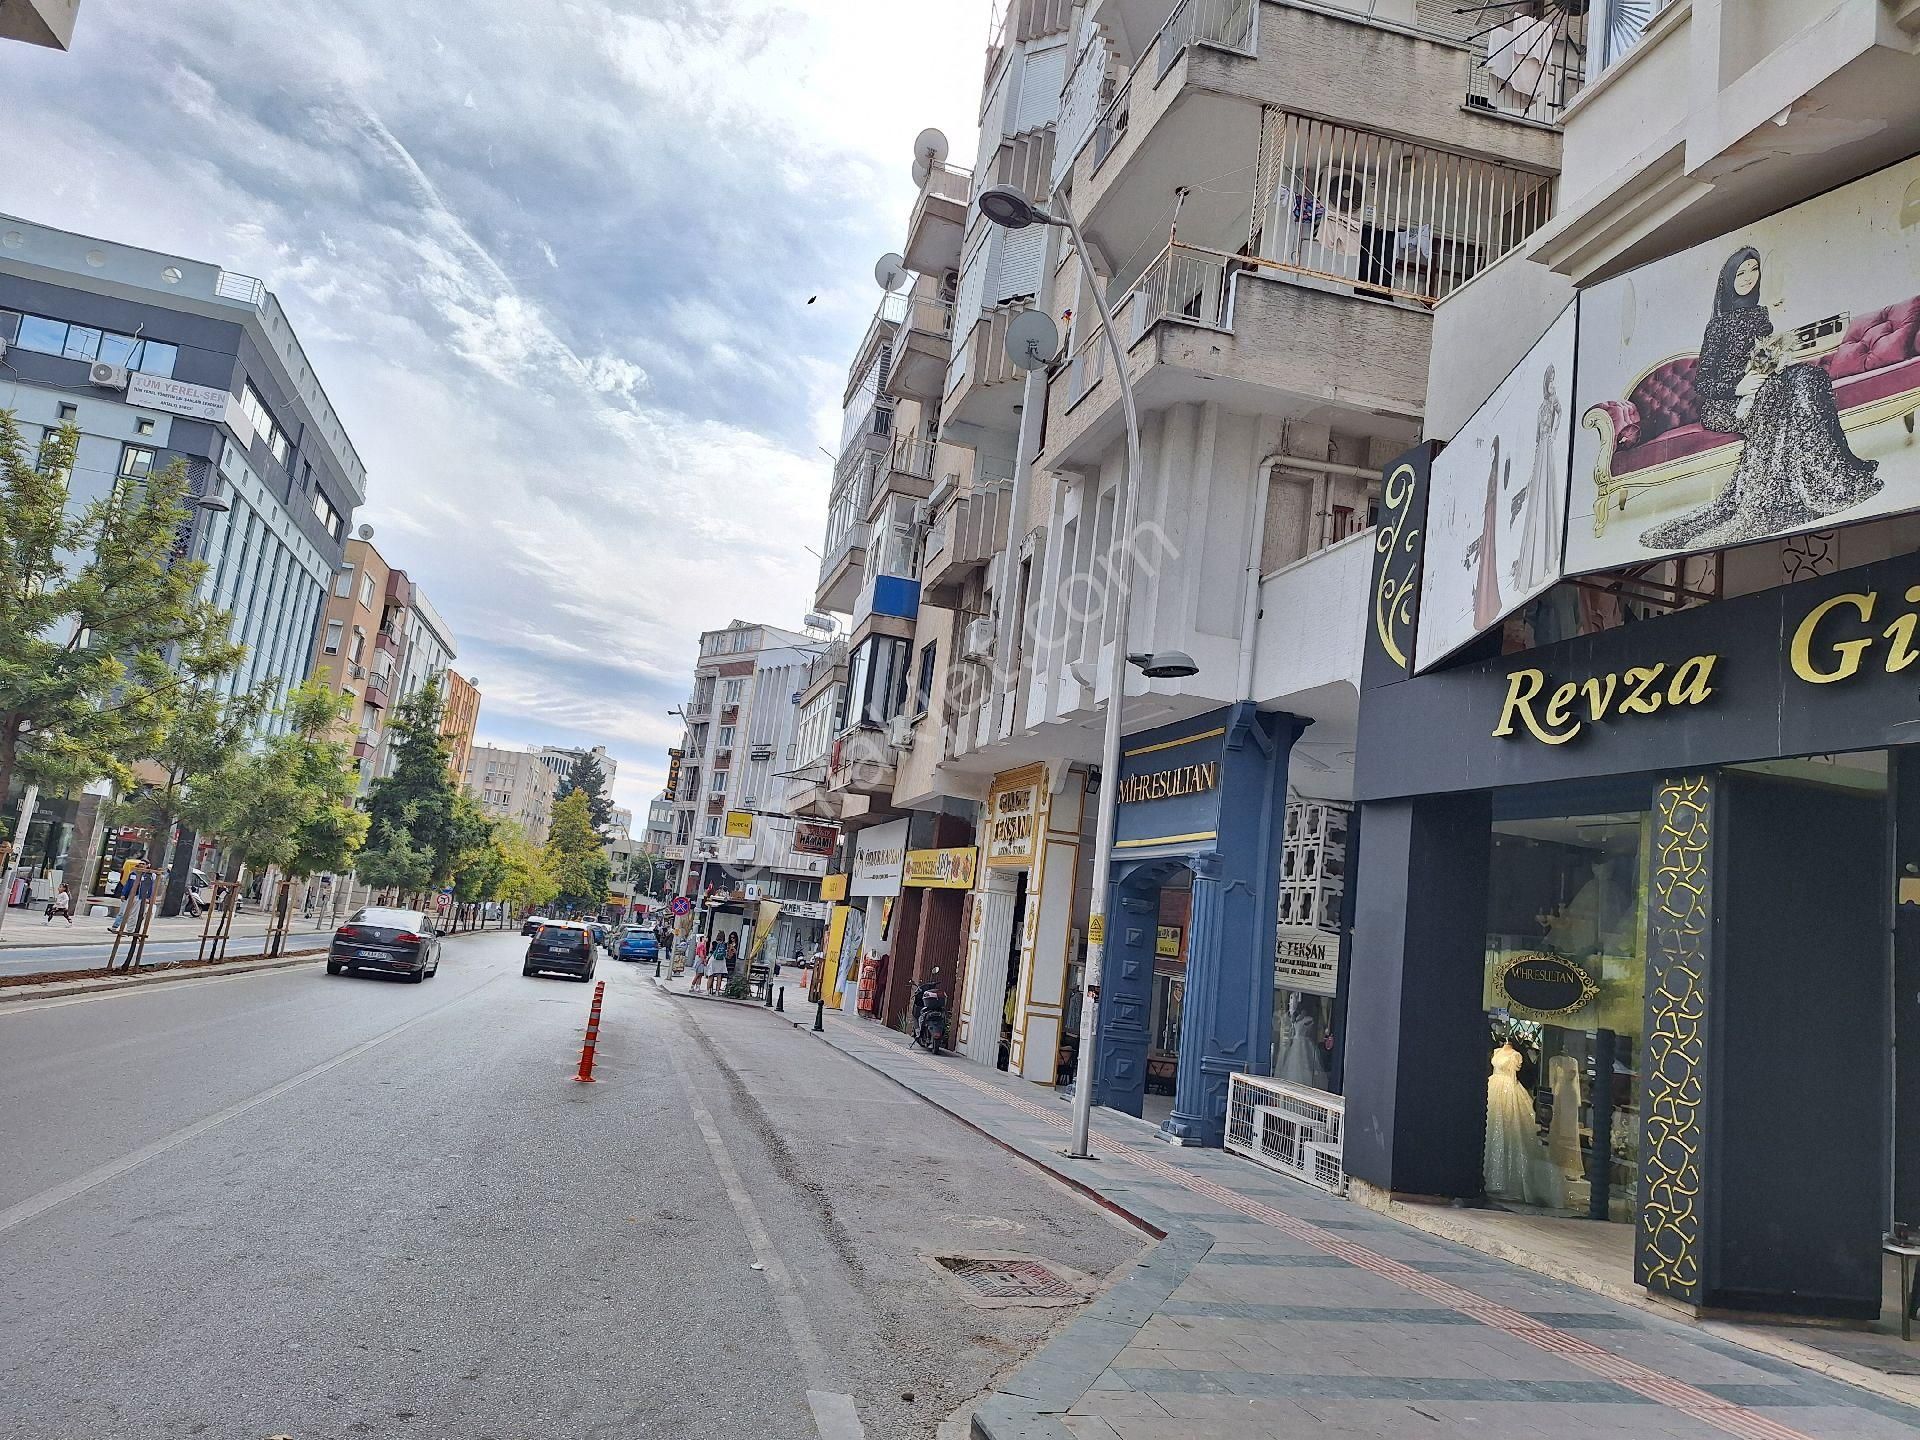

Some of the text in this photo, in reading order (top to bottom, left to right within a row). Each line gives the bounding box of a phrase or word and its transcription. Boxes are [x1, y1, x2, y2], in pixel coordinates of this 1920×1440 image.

[135, 375, 227, 403] TÜM YEREL-SEN
[1492, 654, 1718, 745] Revza
[1118, 760, 1217, 803] MİHRESULTAN
